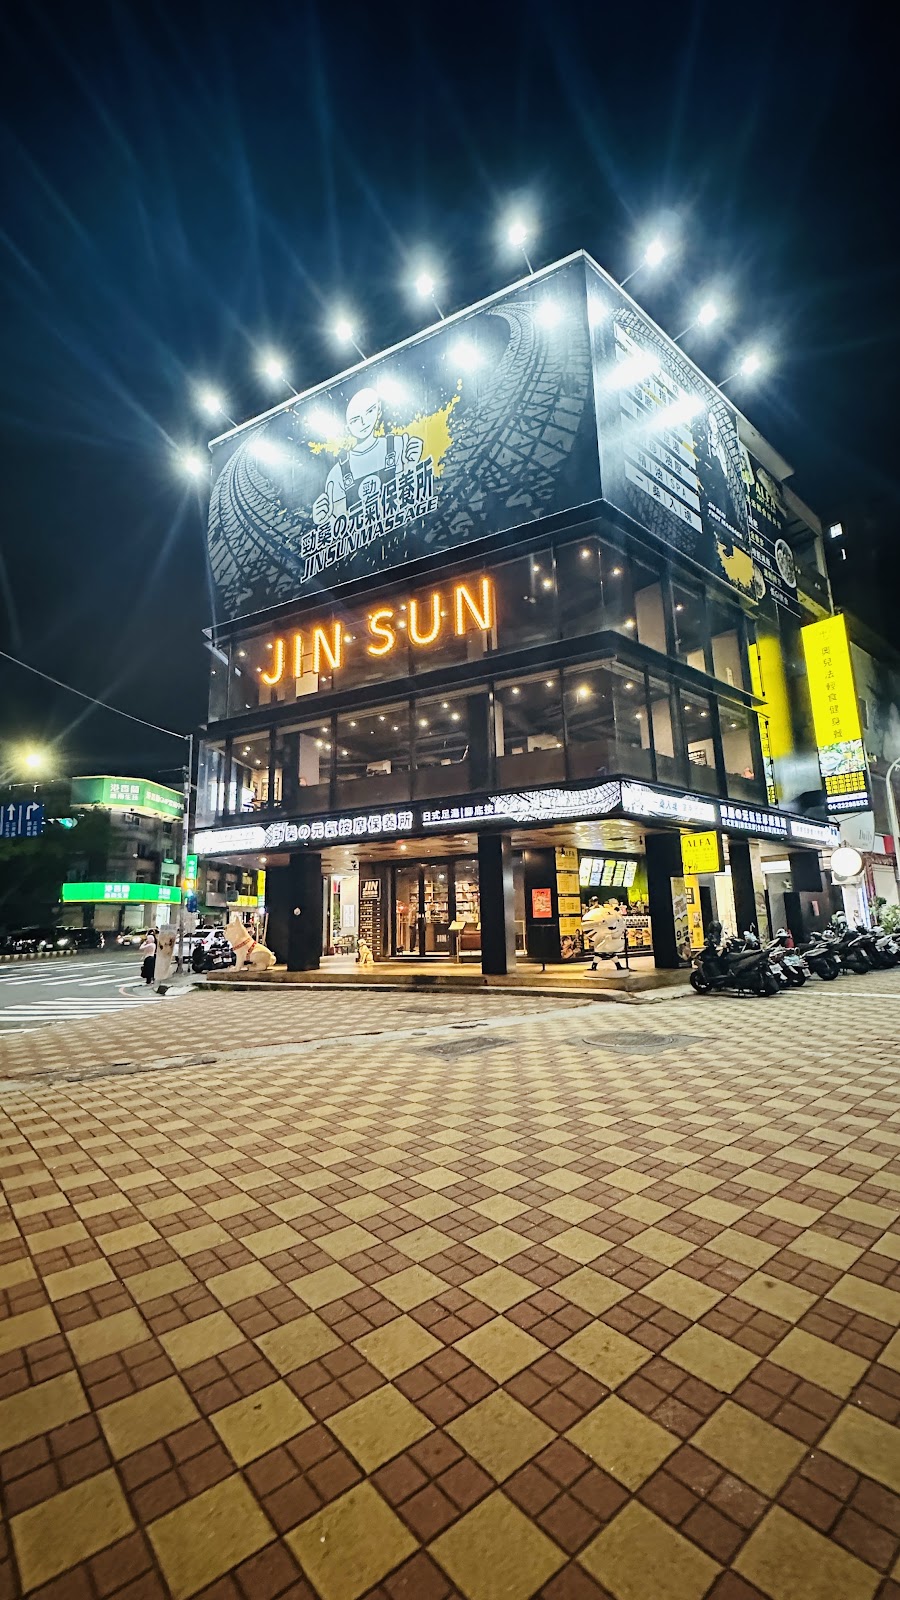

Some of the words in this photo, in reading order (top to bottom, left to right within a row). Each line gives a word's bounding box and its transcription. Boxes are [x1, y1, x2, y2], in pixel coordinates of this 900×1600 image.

[261, 620, 342, 685] JIN
[367, 576, 493, 656] SUN
[362, 880, 379, 891] JIN
